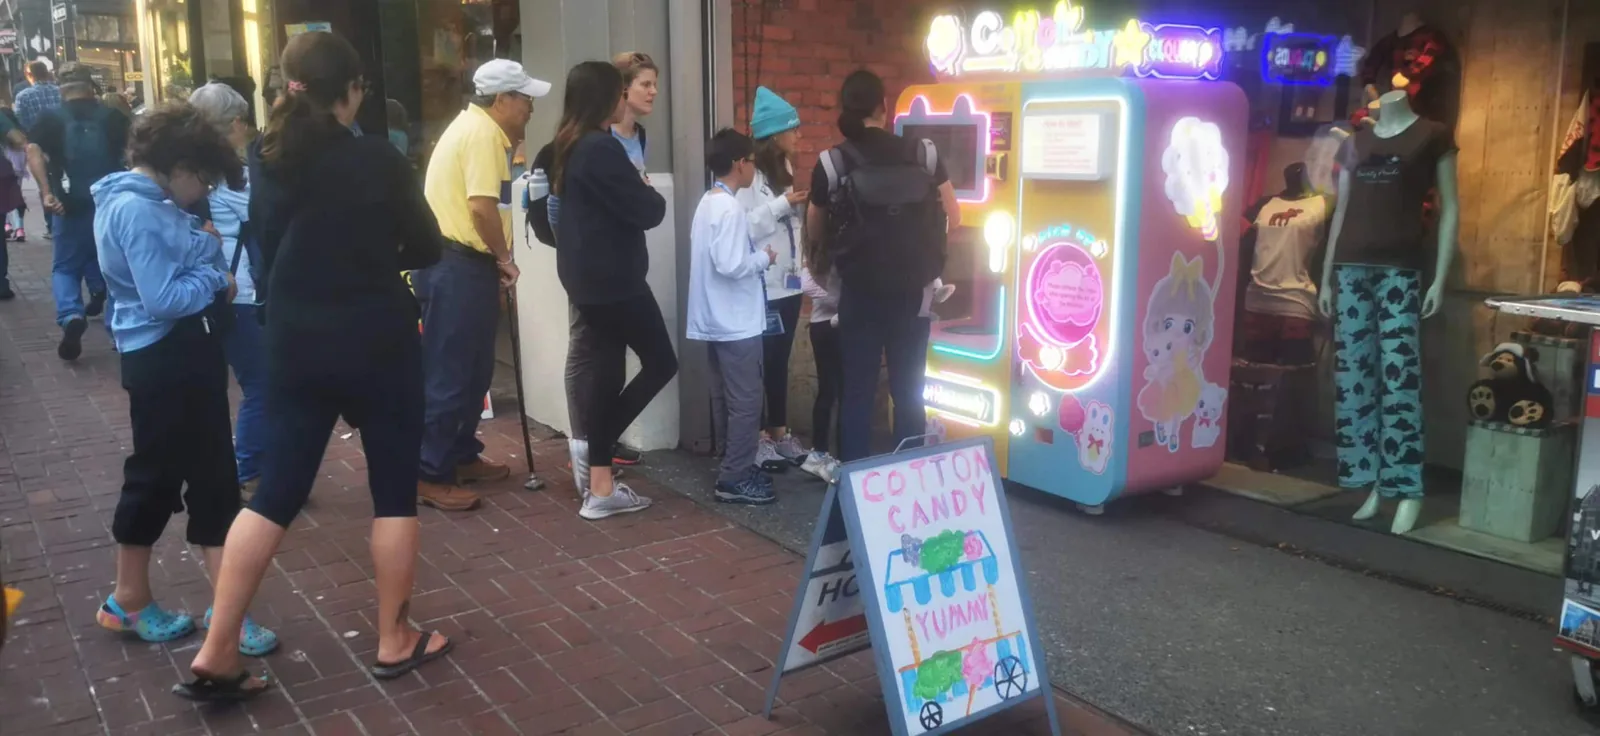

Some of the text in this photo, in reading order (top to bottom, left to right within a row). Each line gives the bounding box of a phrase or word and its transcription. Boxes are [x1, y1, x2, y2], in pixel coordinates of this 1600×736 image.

[861, 448, 992, 503] COTTON
[888, 482, 986, 534] CANDY
[916, 593, 990, 643] YUMMY
